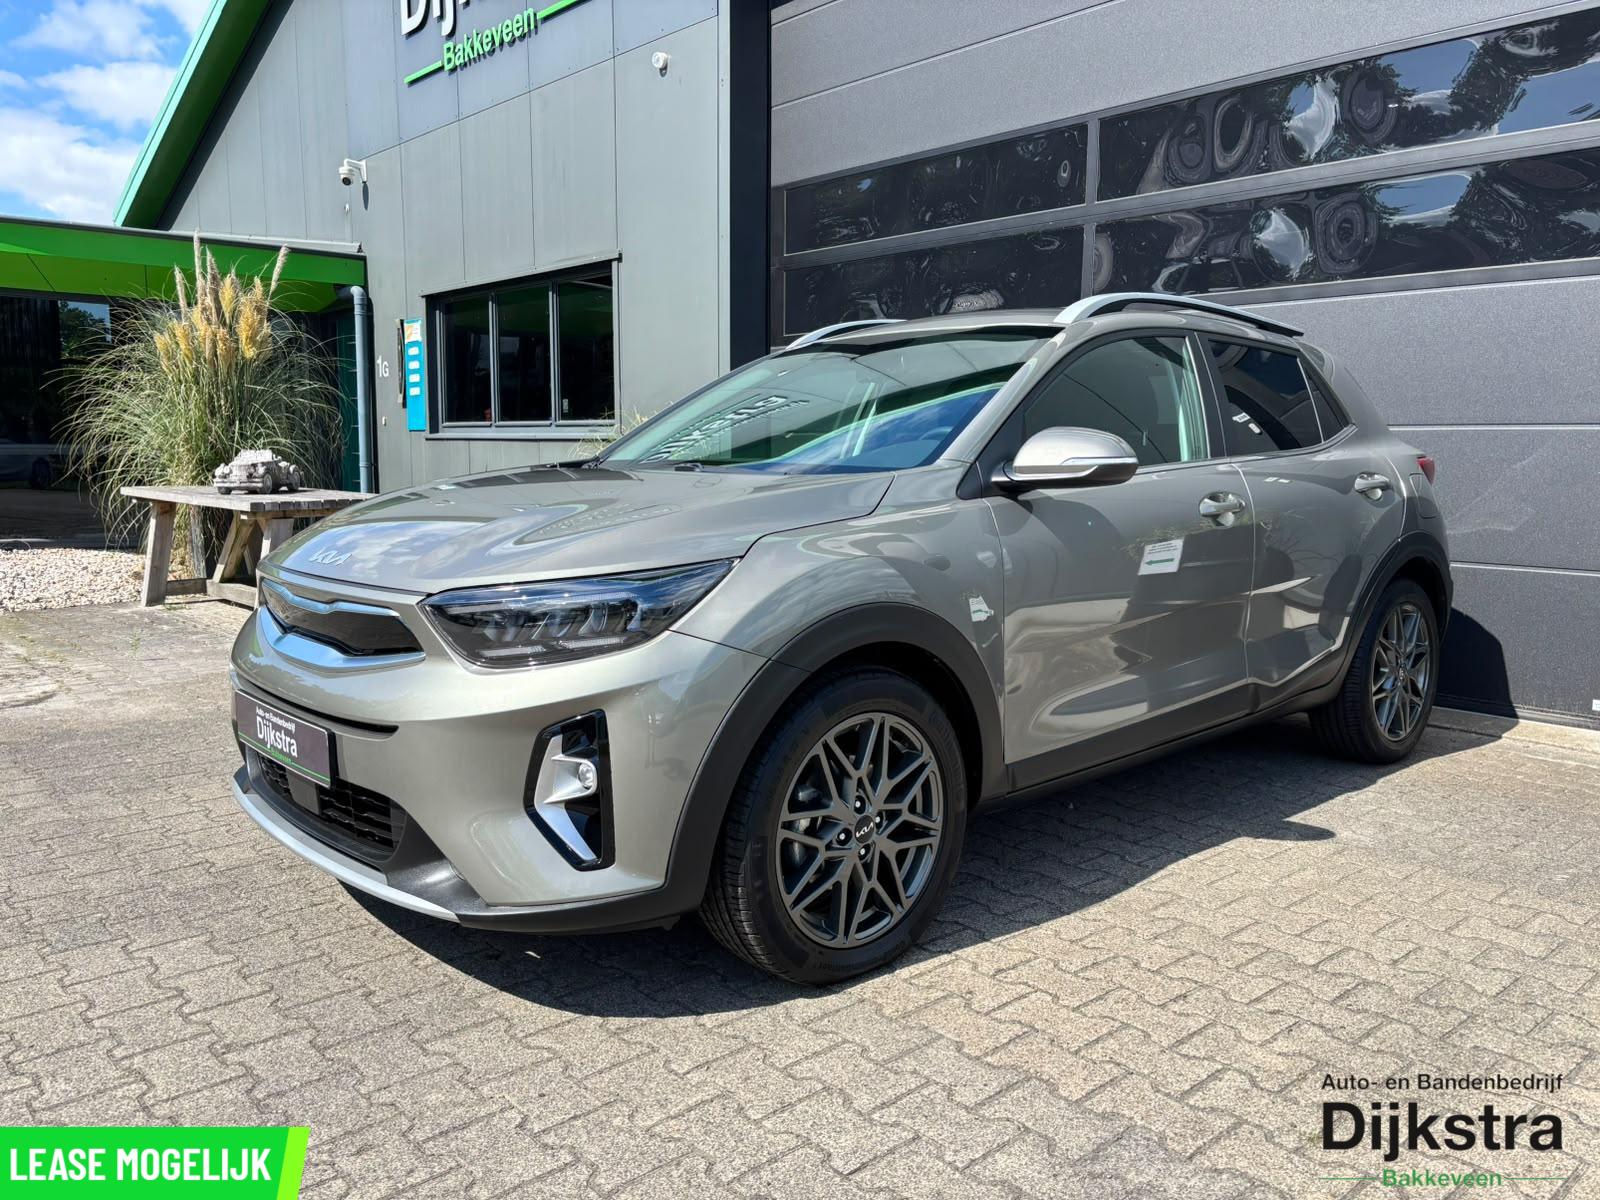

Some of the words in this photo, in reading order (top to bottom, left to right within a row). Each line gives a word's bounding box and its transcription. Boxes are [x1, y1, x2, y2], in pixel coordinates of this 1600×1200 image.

[443, 7, 535, 71] Bakkeveen
[376, 355, 389, 378] 1G
[308, 546, 353, 566] KIA
[256, 715, 298, 758] Dijkstra
[855, 821, 874, 838] KIA
